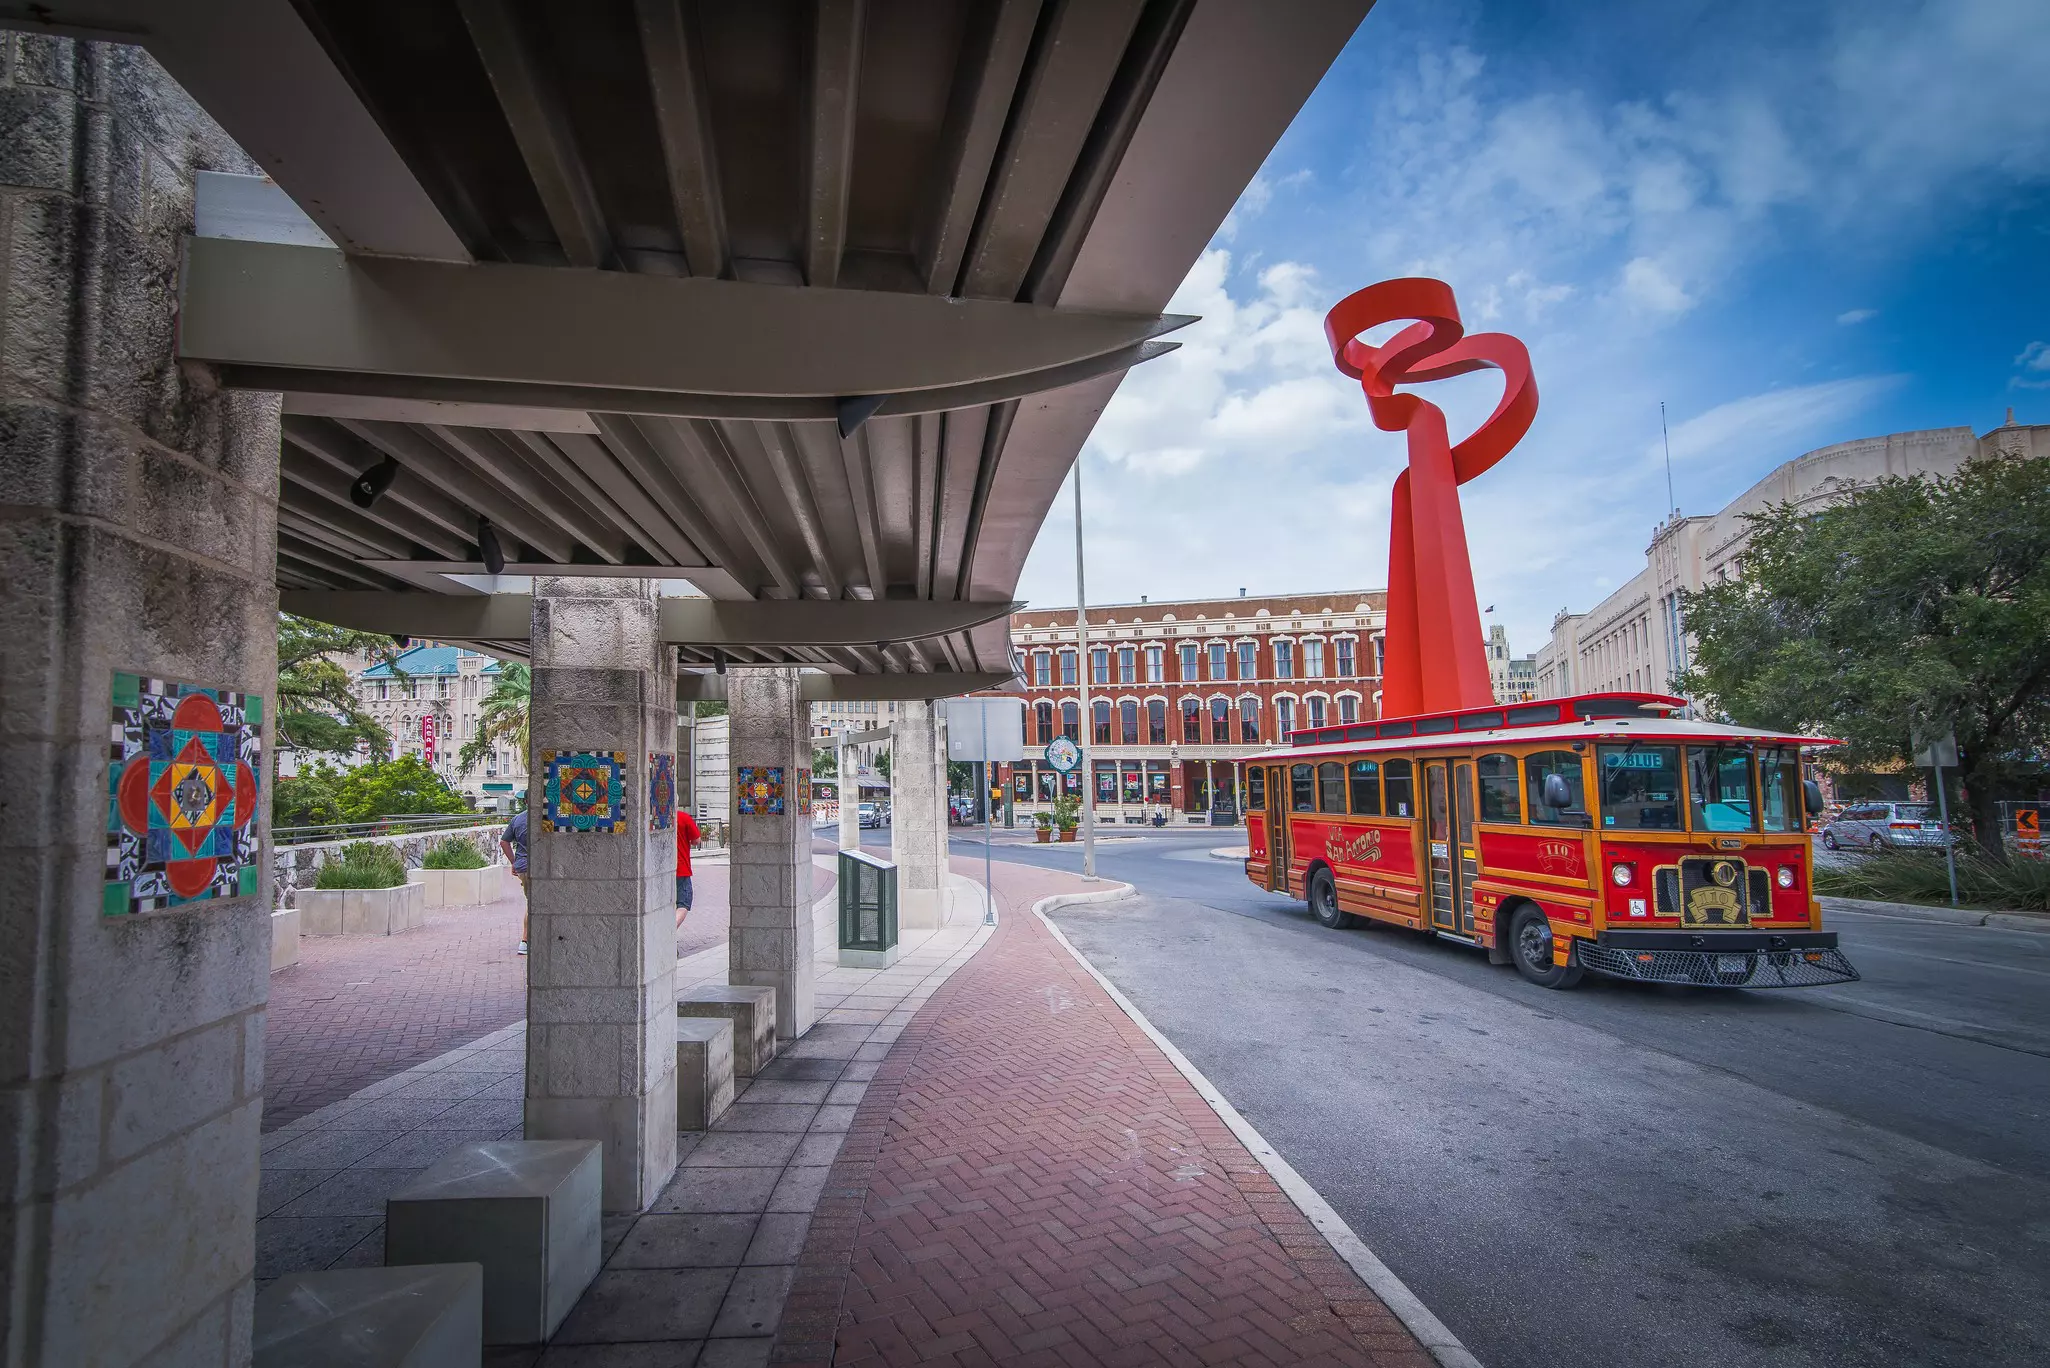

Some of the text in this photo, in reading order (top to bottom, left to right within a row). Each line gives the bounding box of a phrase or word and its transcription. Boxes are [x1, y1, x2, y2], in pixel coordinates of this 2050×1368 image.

[1626, 754, 1660, 767] BLUE
[1327, 825, 1344, 841] VIA
[1546, 843, 1569, 857] 110
[1698, 891, 1729, 905] 110
